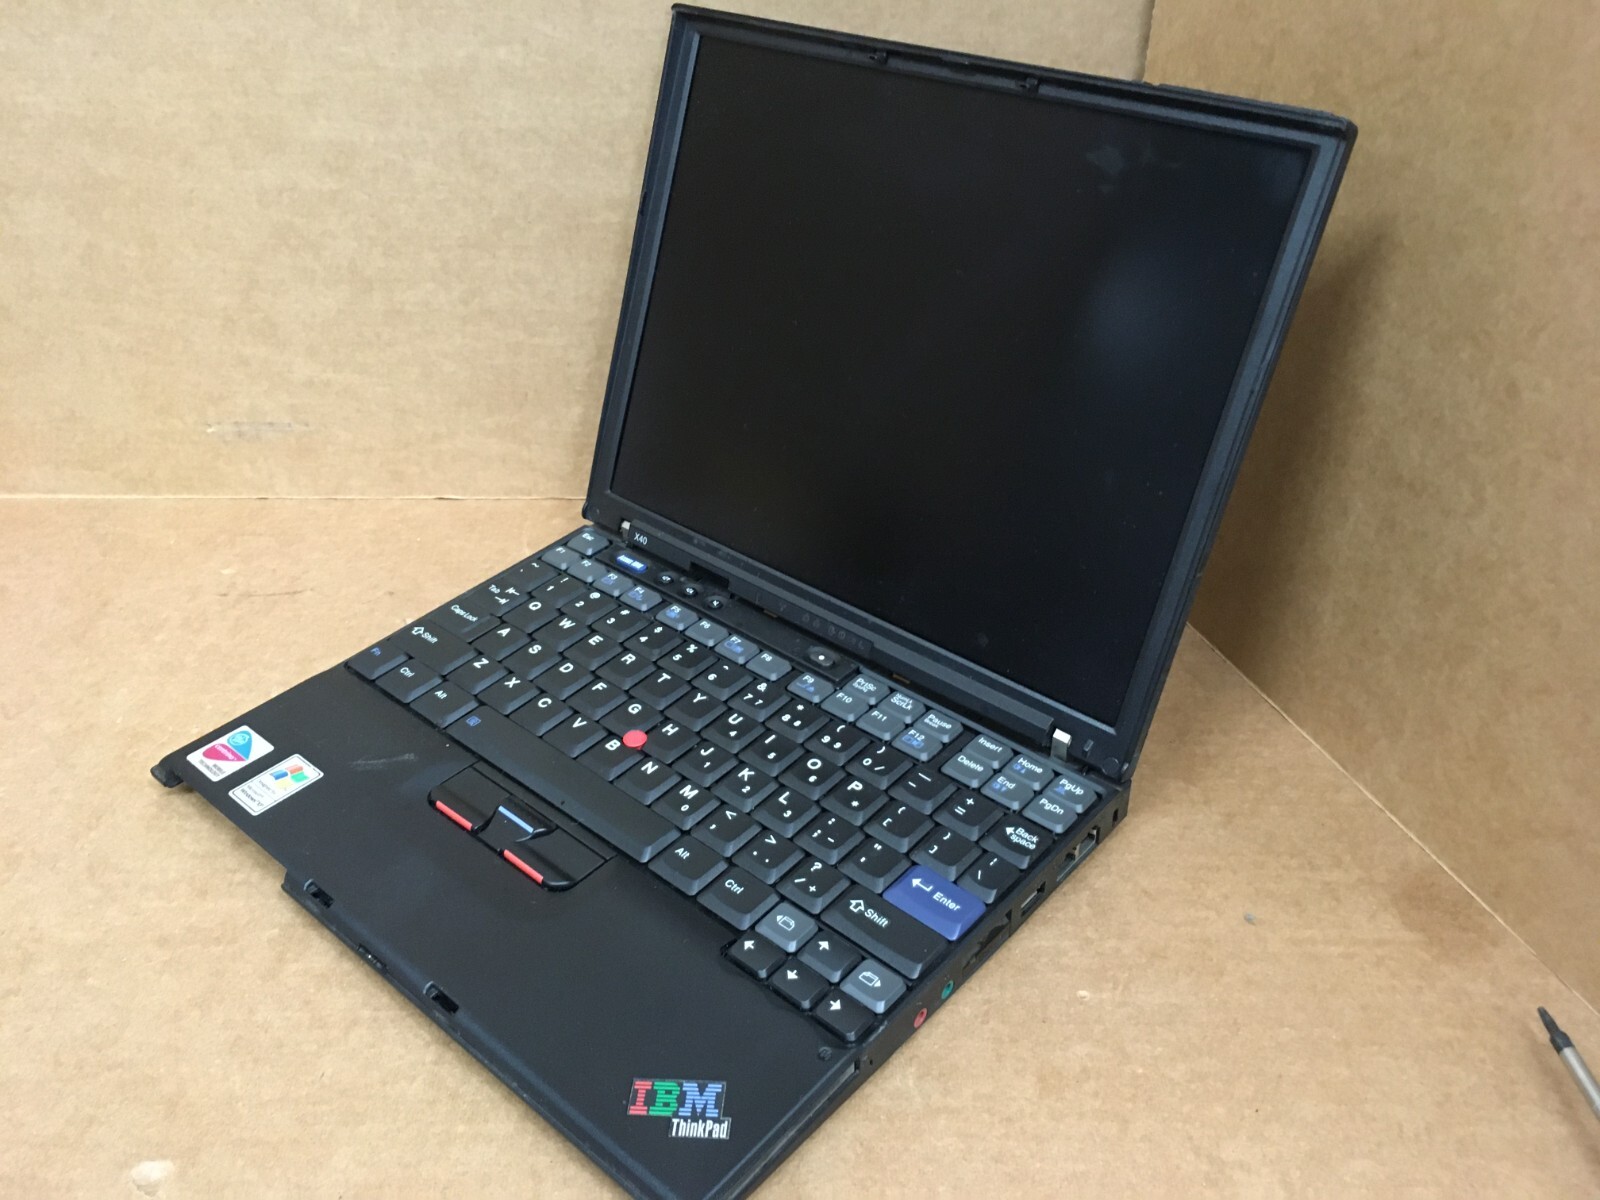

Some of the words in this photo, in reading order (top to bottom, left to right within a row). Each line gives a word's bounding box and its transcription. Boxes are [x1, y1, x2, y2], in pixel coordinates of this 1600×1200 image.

[634, 532, 648, 545] X40
[581, 559, 591, 567] F2
[607, 572, 618, 581] F3
[488, 584, 501, 594] Tab
[634, 586, 646, 595] F4
[451, 604, 466, 617] Caps
[464, 612, 478, 622] Lock
[670, 605, 682, 613] F5
[558, 617, 576, 629] W
[700, 621, 711, 629] F6
[421, 632, 438, 644] Shift
[497, 627, 511, 637] A
[588, 635, 604, 646] E
[730, 636, 742, 644] F7
[528, 644, 542, 655] S
[472, 657, 490, 669] Z
[621, 653, 637, 665] R
[761, 653, 773, 662] F8
[400, 667, 415, 678] Ctrl
[559, 663, 574, 673] D
[504, 677, 521, 688] X
[657, 673, 671, 683] T
[707, 673, 718, 681] 6
[802, 675, 815, 684] F9
[591, 682, 608, 691] F
[434, 690, 448, 700] Alt
[693, 693, 707, 703] Y
[836, 692, 853, 703] F10
[537, 697, 552, 708] C
[628, 703, 642, 714] G
[728, 713, 744, 725] U
[781, 713, 792, 722] 8
[871, 710, 887, 722] F11
[927, 714, 952, 729] Pause
[572, 717, 587, 728] V
[661, 723, 679, 736] H
[908, 729, 925, 741] F12
[605, 739, 621, 751] B
[821, 735, 831, 743] 9
[978, 737, 1003, 753] Insert
[700, 747, 715, 757] J
[641, 761, 659, 775] N
[806, 758, 822, 770] O
[957, 755, 984, 773] Delete
[1017, 757, 1044, 774] Home
[737, 767, 755, 782] K
[846, 780, 863, 791] P
[996, 776, 1016, 790] End
[1059, 778, 1085, 796] PgUp
[679, 784, 699, 799] M
[741, 785, 751, 794] 2
[778, 791, 790, 805] L
[1039, 798, 1064, 815] PgDn
[783, 810, 792, 818] 3
[1015, 827, 1039, 843] Back
[1010, 833, 1036, 850] space
[674, 847, 690, 860] Alt
[725, 879, 745, 895] Ctrl
[932, 892, 961, 911] Enter
[864, 908, 889, 928] Shift
[629, 1081, 722, 1117] IBM
[671, 1118, 728, 1138] ThinkPad
